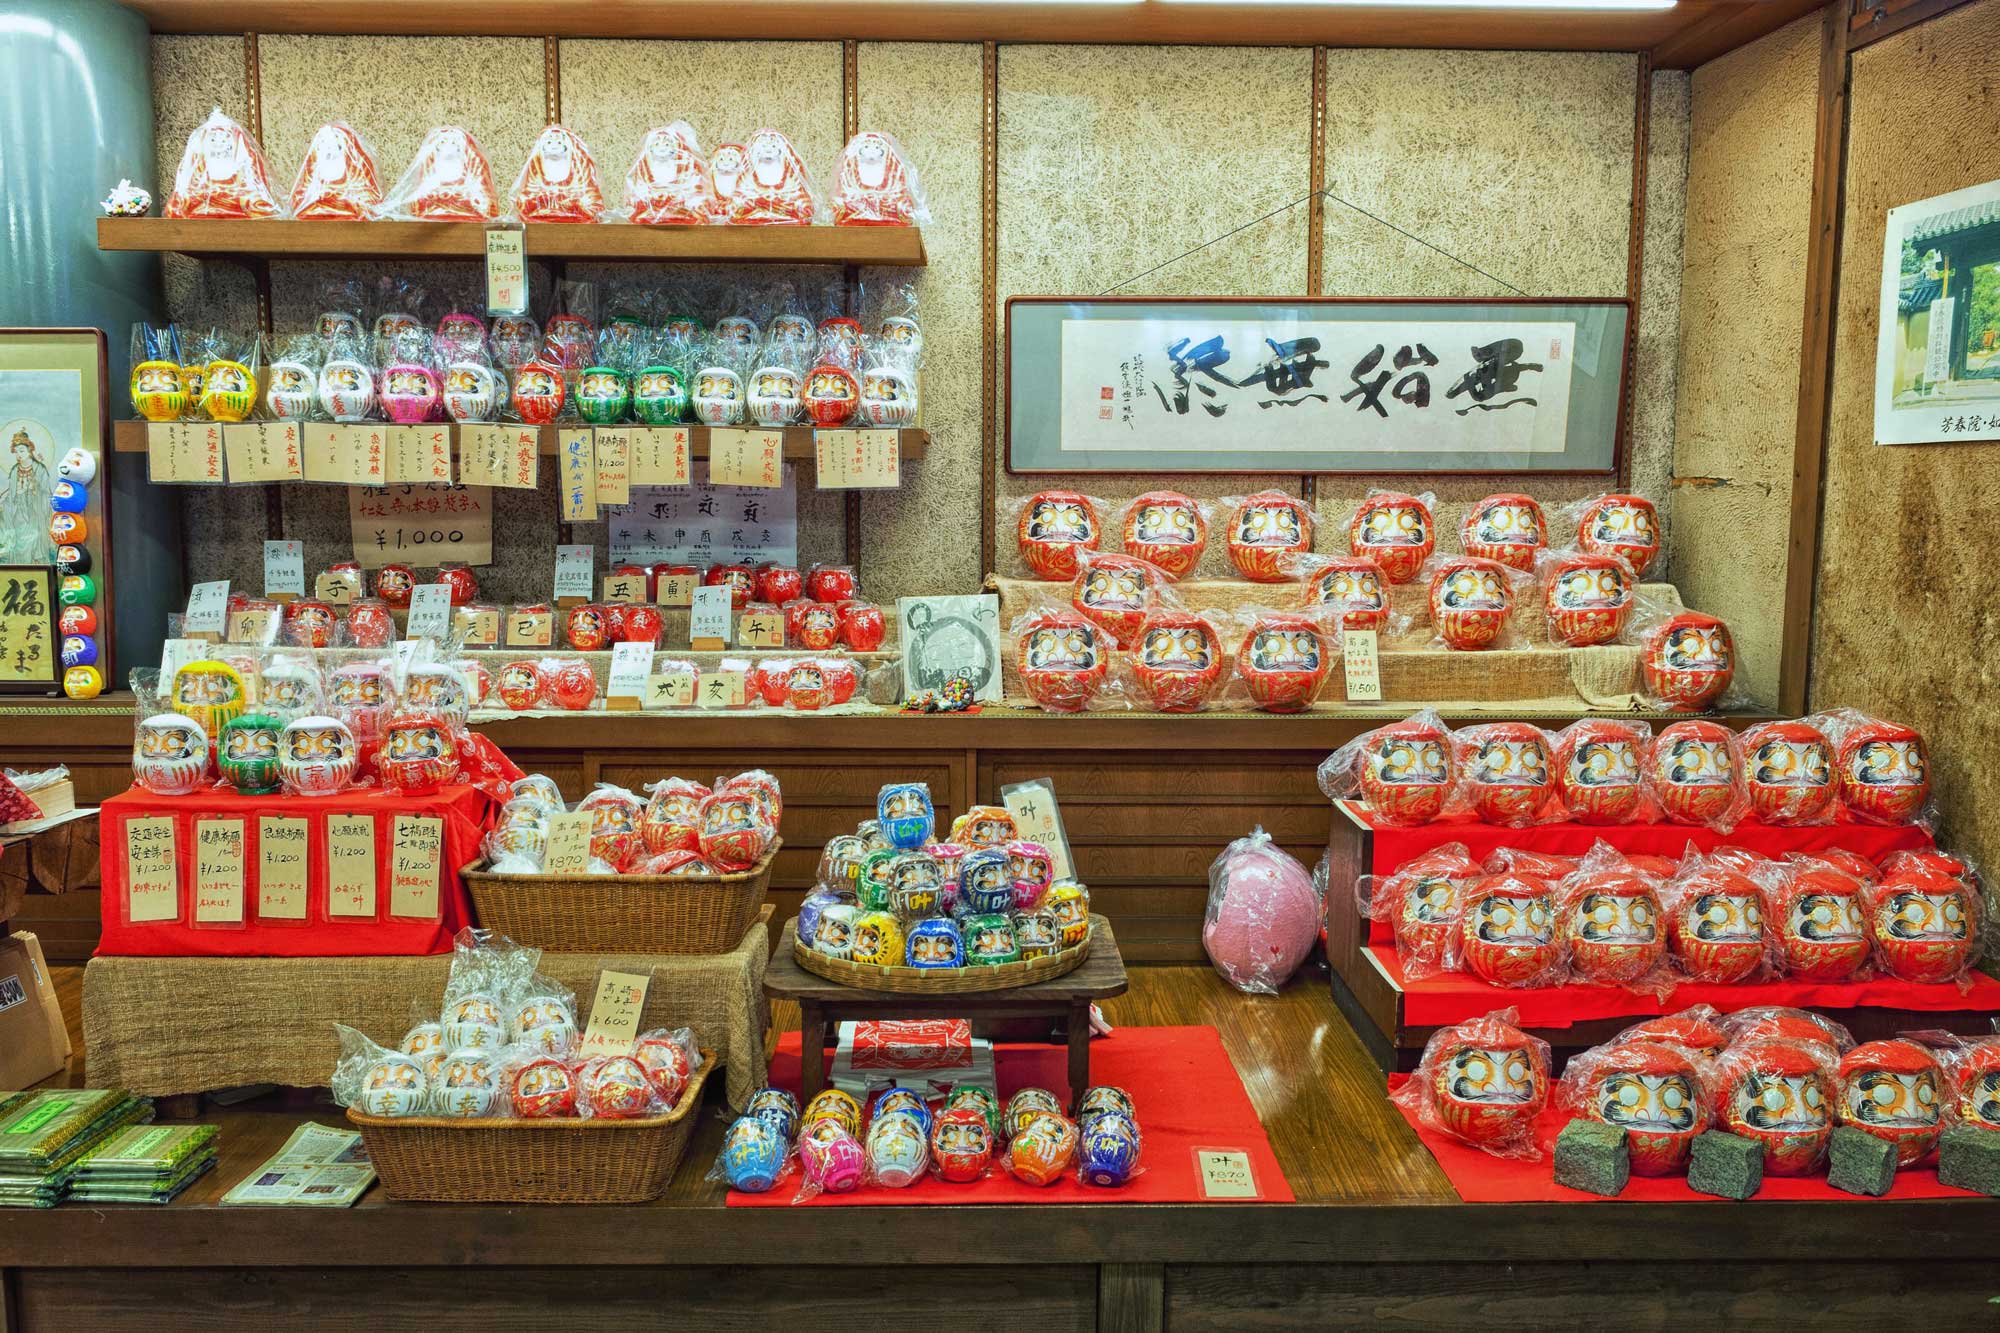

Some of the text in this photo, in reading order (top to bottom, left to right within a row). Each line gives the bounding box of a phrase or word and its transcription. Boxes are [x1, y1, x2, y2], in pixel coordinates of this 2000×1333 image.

[207, 427, 219, 477] 交通安全
[285, 426, 300, 475] 安全第一
[368, 432, 381, 475] 良縁祈願
[430, 431, 448, 477] 七転八起
[517, 431, 536, 485] 無病息災
[673, 431, 687, 480] 健康祈願
[762, 436, 778, 482] 心願成就
[619, 529, 631, 542] 午
[675, 528, 686, 544] 申
[700, 529, 711, 543] 酉
[326, 580, 348, 597] 子
[610, 582, 631, 598] 丑
[667, 579, 679, 598] 寅
[241, 616, 254, 638] 卯
[748, 618, 766, 641] 午
[1020, 800, 1037, 820] 叶
[129, 826, 172, 840] 交通安全
[200, 829, 241, 846] 健康祈願
[263, 824, 305, 841] 良縁祈願
[331, 824, 370, 837] 心願成就
[398, 822, 439, 839] 七福即生
[899, 822, 924, 837] 叶
[131, 844, 172, 861] 安全第一
[549, 855, 583, 868] ¥870
[352, 895, 364, 910] 叶
[910, 891, 932, 909] 叶
[992, 895, 1011, 909] 叶
[375, 1092, 401, 1116] 幸
[454, 1093, 480, 1117] 幸
[1211, 1156, 1232, 1167] 叶
[1208, 1170, 1245, 1179] ¥870
